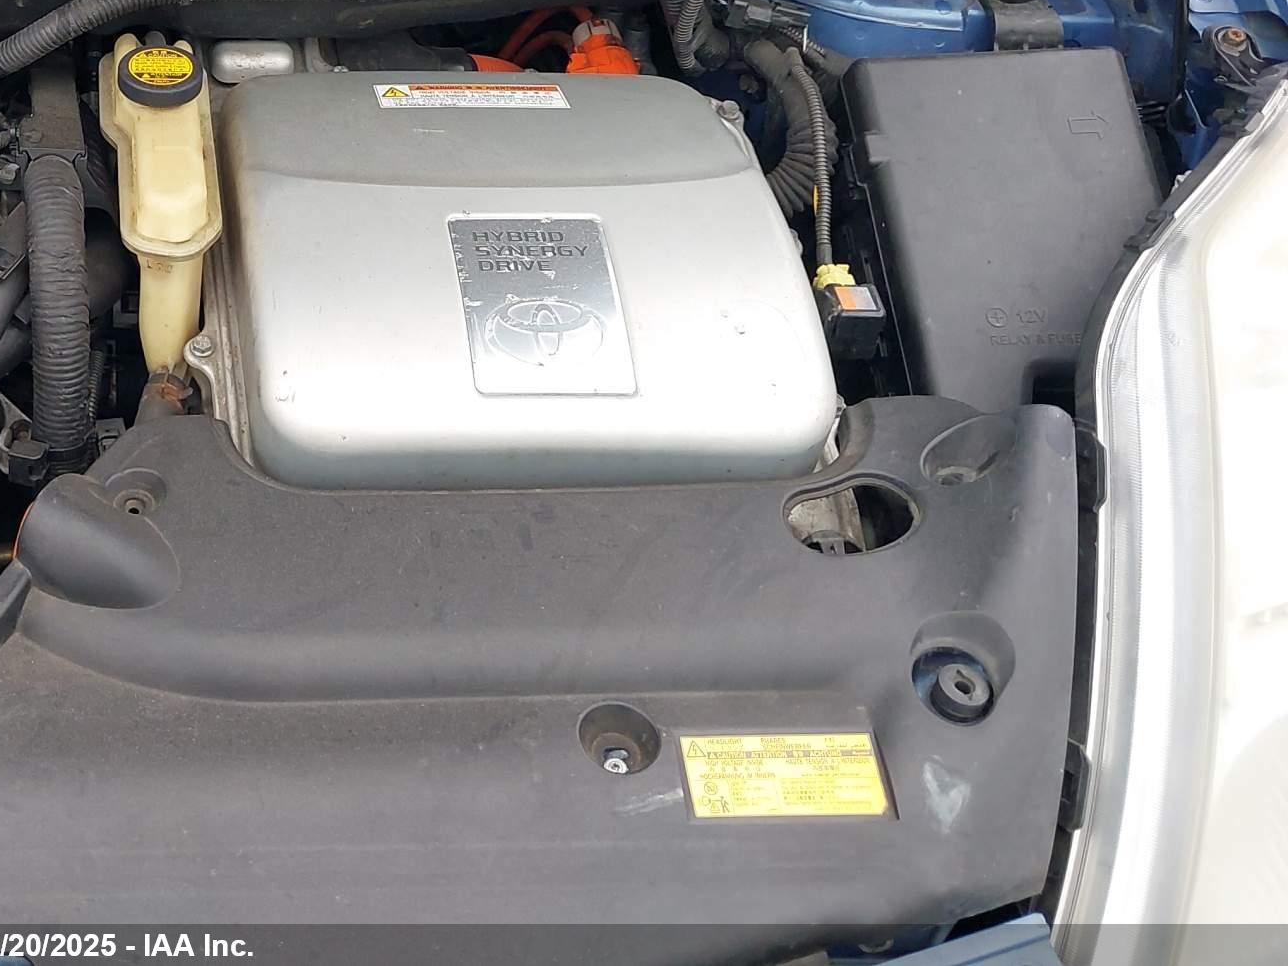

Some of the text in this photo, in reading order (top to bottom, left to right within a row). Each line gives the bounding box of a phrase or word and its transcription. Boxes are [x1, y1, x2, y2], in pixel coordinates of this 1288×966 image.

[472, 231, 565, 242] HYBRID
[474, 245, 589, 257] SYNERGY
[478, 260, 554, 272] DRIVE
[1016, 309, 1046, 324] 12V
